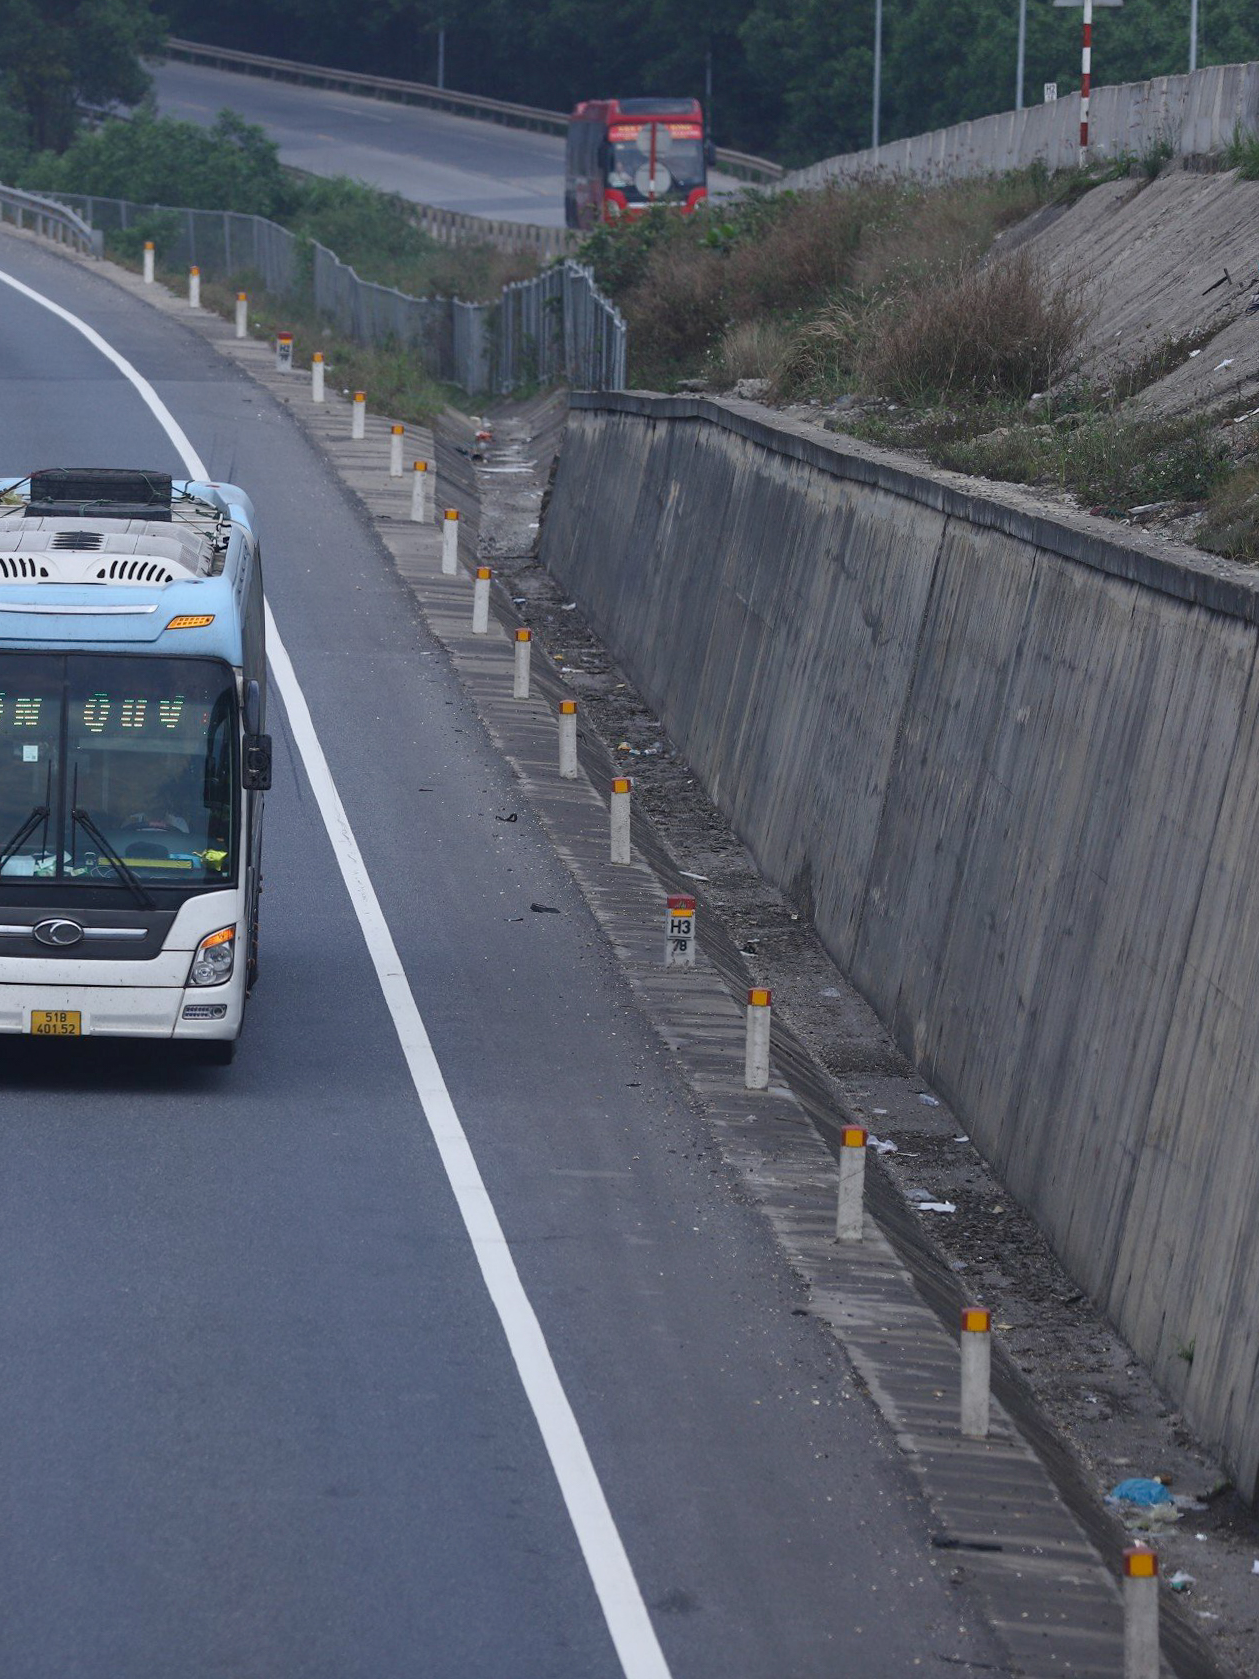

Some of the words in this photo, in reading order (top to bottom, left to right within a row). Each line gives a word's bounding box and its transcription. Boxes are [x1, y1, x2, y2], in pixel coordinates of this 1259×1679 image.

[670, 919, 691, 934] H3
[672, 938, 687, 951] 78
[45, 1012, 67, 1023] 51B
[37, 1023, 76, 1035] 401.52
